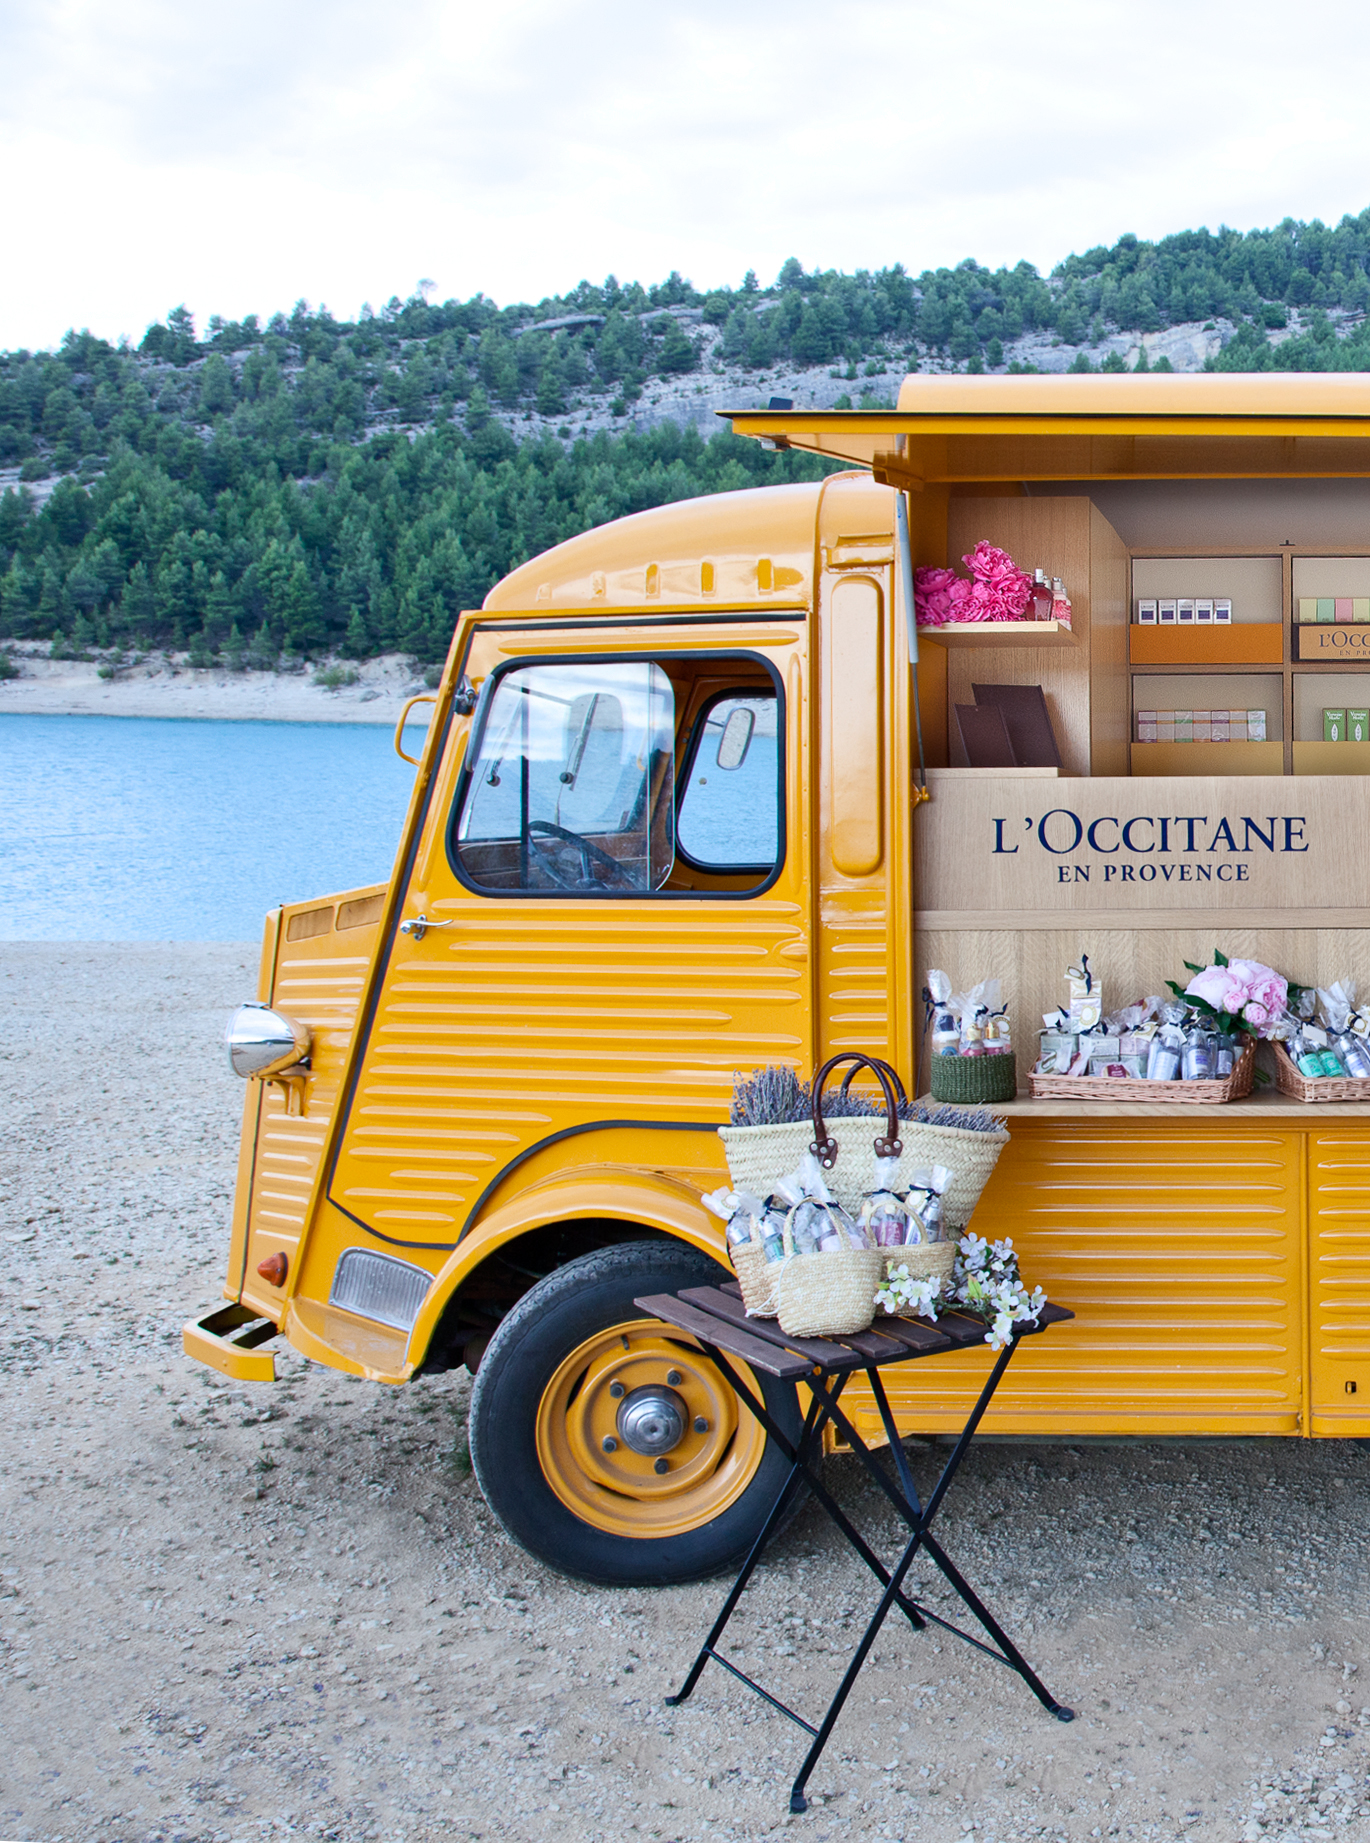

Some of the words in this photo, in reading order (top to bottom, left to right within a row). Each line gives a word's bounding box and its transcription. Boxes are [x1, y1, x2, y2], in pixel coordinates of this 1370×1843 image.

[991, 809, 1310, 854] L'OCCITANE
[1057, 865, 1091, 883] EN
[1104, 864, 1250, 882] PROVENCE
